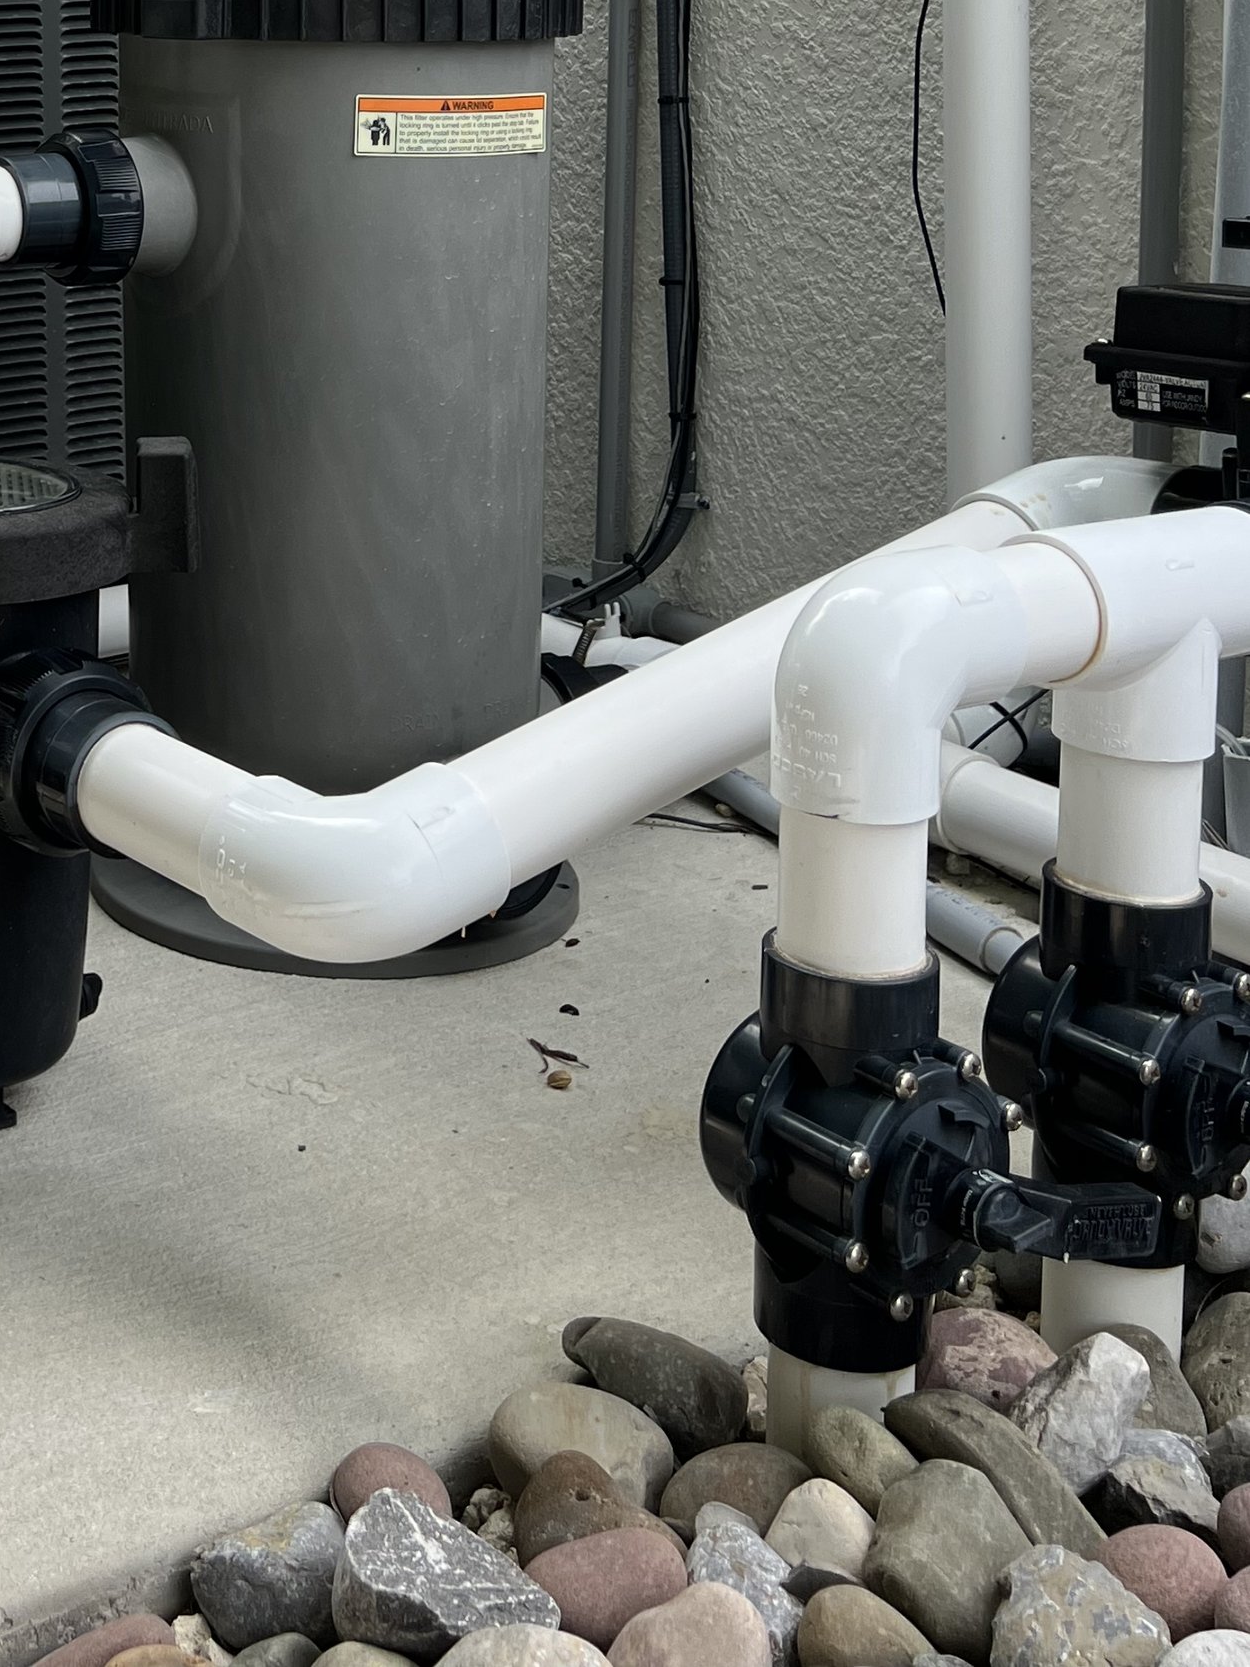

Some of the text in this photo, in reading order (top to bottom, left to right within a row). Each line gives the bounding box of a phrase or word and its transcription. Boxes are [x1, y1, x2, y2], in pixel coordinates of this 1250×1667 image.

[452, 100, 494, 110] WARNING
[429, 114, 454, 122] operates
[399, 122, 421, 130] locking
[423, 122, 434, 130] ring
[406, 130, 431, 138] properly
[461, 129, 479, 137] locking
[419, 137, 446, 145] damaged
[913, 1178, 933, 1227] OFF
